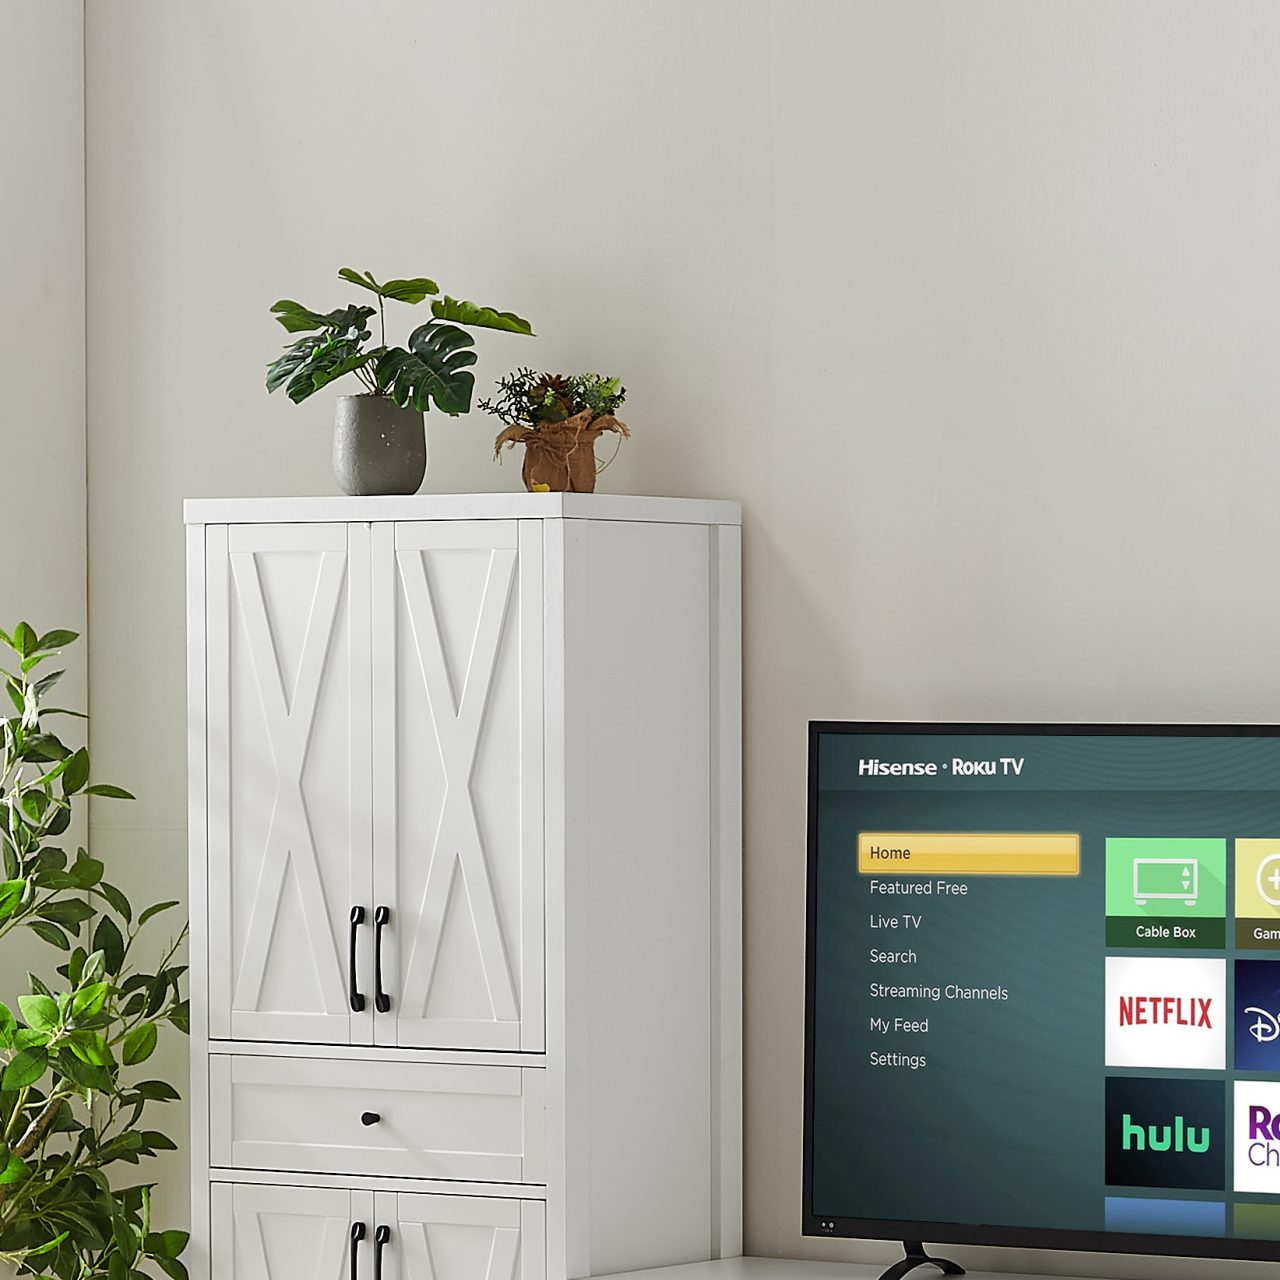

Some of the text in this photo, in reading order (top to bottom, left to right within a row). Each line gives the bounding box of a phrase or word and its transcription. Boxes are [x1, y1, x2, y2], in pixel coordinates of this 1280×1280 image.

[858, 758, 1024, 776] Hisense Roku TV
[870, 846, 911, 860] Home
[870, 880, 968, 895] Featured Free
[870, 915, 922, 929] Live TV
[1136, 926, 1196, 938] Cable Box
[870, 949, 917, 963] Search
[870, 983, 1008, 1001] Streaming Channels
[1119, 996, 1212, 1029] NETFLIX
[870, 1018, 929, 1034] My Feed
[870, 1052, 926, 1068] Settings
[1122, 1113, 1210, 1153] hulu
